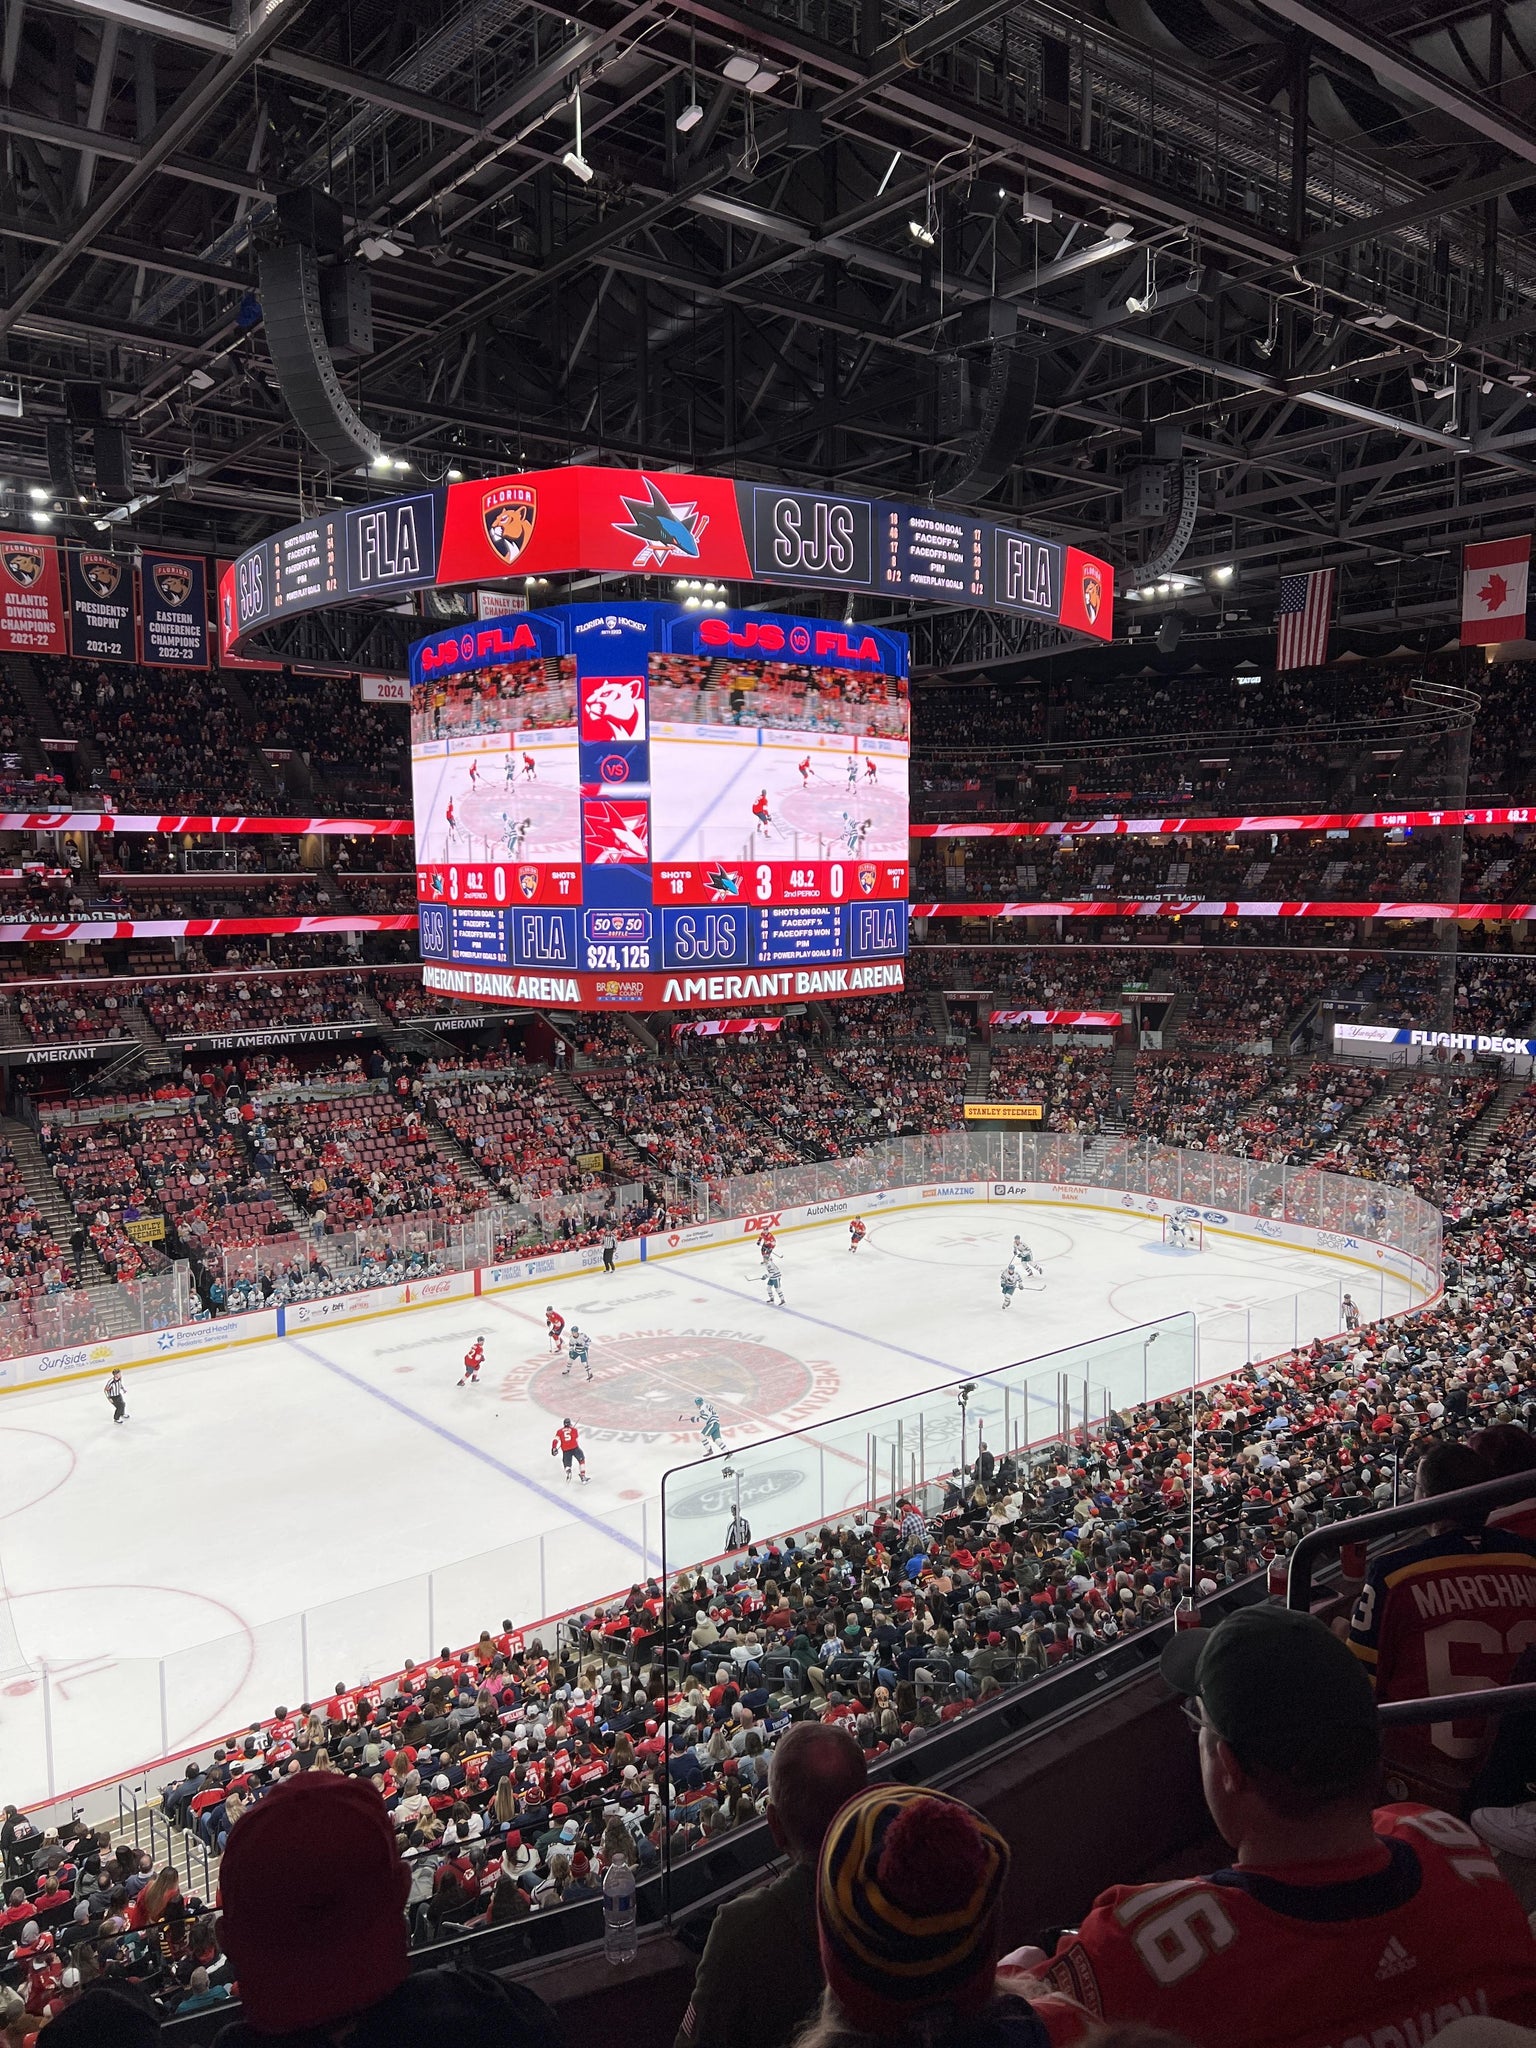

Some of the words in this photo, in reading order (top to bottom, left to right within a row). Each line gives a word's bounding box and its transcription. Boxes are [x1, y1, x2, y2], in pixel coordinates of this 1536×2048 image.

[486, 490, 532, 506] FLORIDA
[910, 518, 934, 530] SHOTS
[935, 522, 945, 532] ON
[946, 524, 963, 536] GOAL
[773, 498, 853, 573] SJS
[915, 533, 952, 547] FACEOFF
[953, 540, 959, 548] %
[359, 506, 419, 581] FLA
[890, 541, 898, 553] 17
[910, 546, 947, 560] FACEOFFS
[948, 552, 963, 562] WON
[930, 563, 945, 573] PIM
[1006, 537, 1051, 608] FLA
[240, 554, 263, 621] SJS
[887, 569, 901, 582] 0/2
[910, 574, 931, 584] POWER
[931, 577, 945, 586] PLAY
[946, 580, 963, 590] GOALS
[971, 583, 983, 594] 0/2
[5, 592, 48, 606] ATLANTIC
[482, 595, 506, 607] STANLEY
[507, 597, 525, 608] CUP
[7, 606, 48, 620] DIVISION
[75, 600, 129, 618] PRESIDENTS'
[86, 615, 120, 629] TROPHY
[156, 611, 192, 624] EASTERN
[1, 619, 56, 634] CHAMPIONS
[149, 622, 201, 636] CONFERENCE
[576, 617, 604, 634] FLORIDA
[618, 616, 647, 633] HOCKEY
[10, 633, 49, 646] 2021-22
[151, 635, 200, 648] CHAMPIONS
[700, 619, 785, 648] SJS
[795, 634, 806, 646] VS
[816, 630, 880, 661] FLA
[87, 640, 121, 654] 2021-22
[159, 647, 194, 659] 2022-23
[422, 640, 459, 670] SJS
[478, 624, 536, 656] FLA
[378, 685, 404, 698] 2024
[606, 764, 623, 775] VS
[1486, 810, 1492, 823] 3
[1508, 810, 1528, 822] 48.2
[552, 871, 576, 880] SHOTS
[660, 871, 691, 879] SHOTS
[756, 864, 772, 900] 3
[790, 870, 814, 887] 48.2
[830, 863, 843, 898] 0
[450, 867, 458, 900] 3
[494, 866, 506, 902] 0
[559, 880, 569, 895] 17
[670, 880, 684, 894] 18
[893, 876, 900, 889] 17
[784, 890, 796, 898] 2nd
[773, 908, 799, 916] SHOTS
[811, 907, 830, 915] GOAL
[594, 918, 610, 930] 50
[626, 918, 642, 930] 50
[782, 919, 816, 927] FACEOFF
[860, 908, 897, 950] FLA
[423, 911, 443, 952] SJS
[521, 915, 567, 960] FLA
[675, 915, 736, 960] SJS
[773, 930, 813, 938] FACEOFFS
[796, 940, 809, 948] PIM
[587, 945, 650, 970] $24,125
[773, 952, 794, 960] POWER
[475, 972, 515, 995] BANK
[517, 976, 581, 1002] ARENA
[663, 972, 793, 1002] AMERANT
[796, 969, 848, 994] BANK
[850, 964, 904, 990] ARENA
[434, 1018, 485, 1031] AMERANT
[1348, 1025, 1390, 1039] Yuengling
[211, 1038, 234, 1049] THE
[236, 1033, 296, 1048] AMERANT
[300, 1030, 340, 1043] VAULT
[1411, 1030, 1476, 1050] FLIGHT
[1477, 1036, 1530, 1055] DECK
[26, 1048, 96, 1064] AMERANT
[968, 1108, 1001, 1116] STANLEY
[1002, 1108, 1038, 1116] STEEMER
[937, 1187, 975, 1196] AMAZING
[1052, 1185, 1088, 1194] AMERANT
[806, 1202, 848, 1216] AutoNation
[744, 1213, 782, 1232] DEX
[1206, 1213, 1225, 1222] Ford
[128, 1221, 161, 1234] STANLEY
[1317, 1231, 1344, 1243] OMEGA
[1317, 1239, 1344, 1250] SPORT
[1344, 1237, 1359, 1249] XL
[177, 1328, 211, 1340] Broward
[212, 1322, 238, 1333] Health
[600, 1328, 675, 1345] BANK
[676, 1328, 767, 1344] ARENA
[177, 1338, 203, 1348] Pediatric
[204, 1333, 228, 1343] Services
[39, 1351, 87, 1372] Surfside
[564, 1430, 571, 1441] 5
